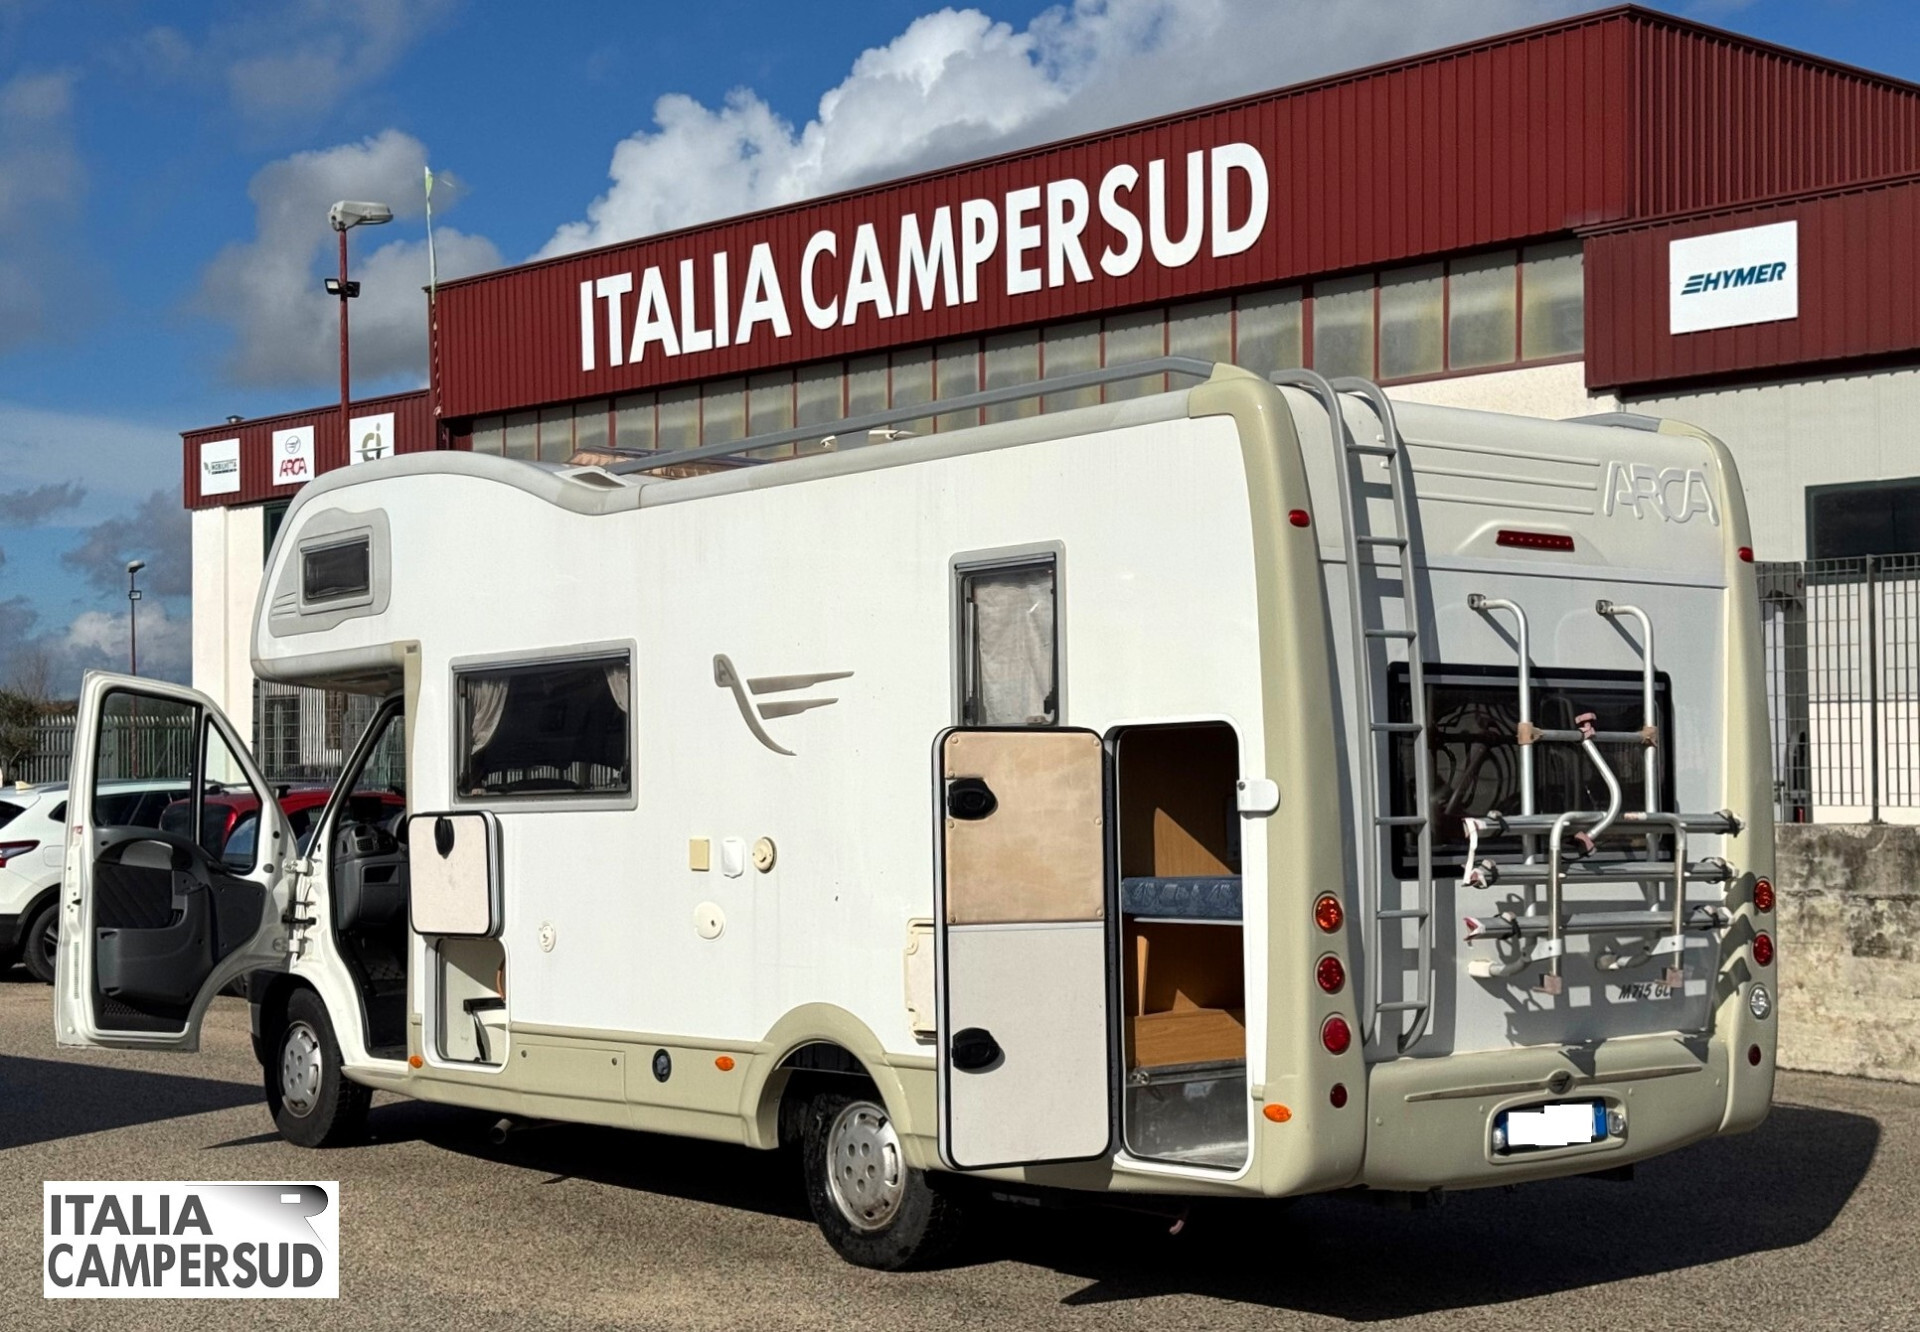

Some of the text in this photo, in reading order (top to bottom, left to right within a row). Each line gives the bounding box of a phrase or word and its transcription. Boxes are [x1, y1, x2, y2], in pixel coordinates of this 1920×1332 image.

[580, 143, 1269, 371] ITALIA CAMPERSUD
[1701, 261, 1787, 292] HYMER
[279, 457, 307, 477] ARCA
[1604, 461, 1719, 525] ARCA
